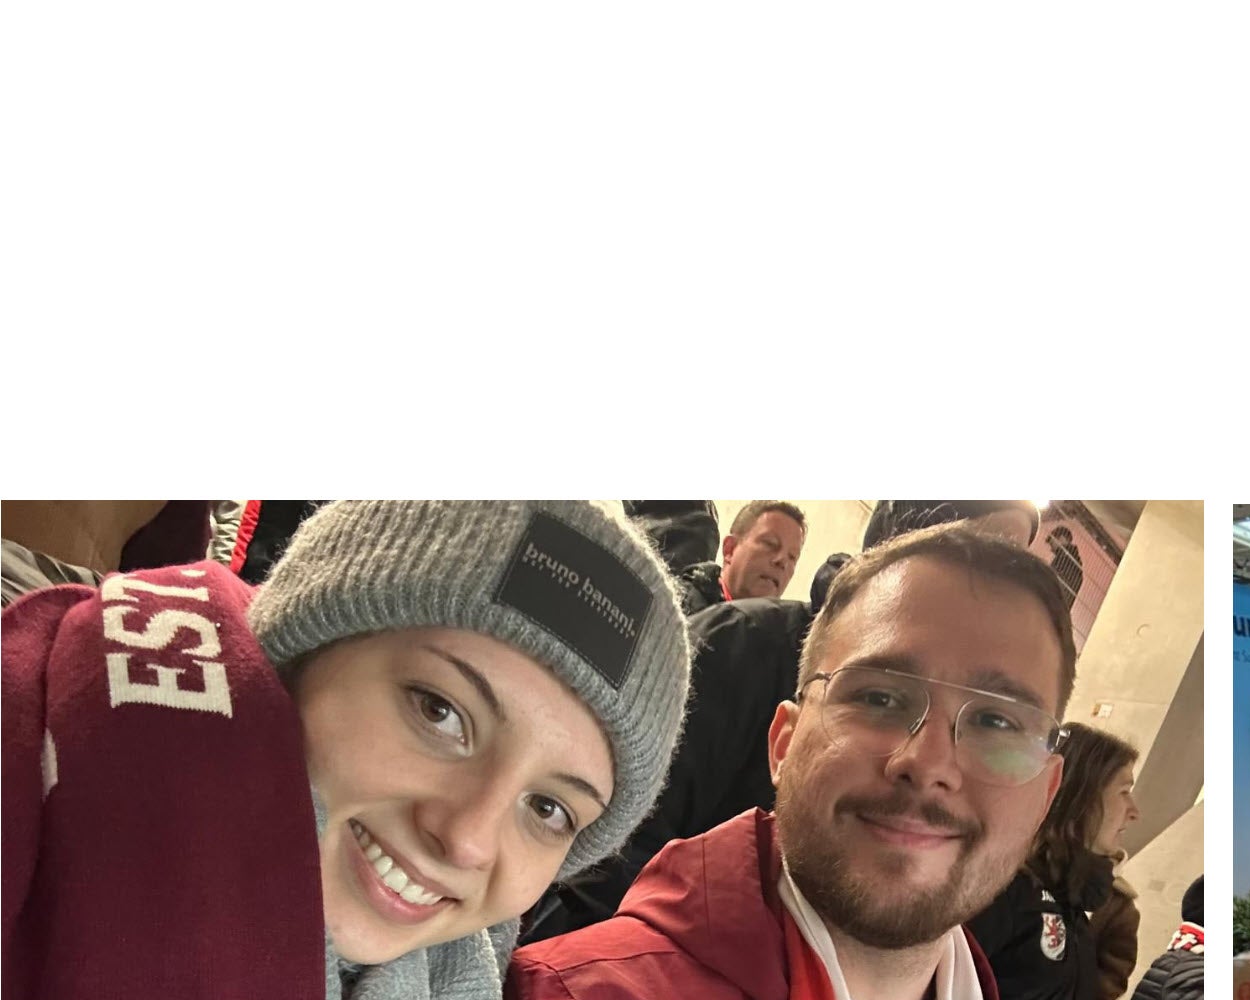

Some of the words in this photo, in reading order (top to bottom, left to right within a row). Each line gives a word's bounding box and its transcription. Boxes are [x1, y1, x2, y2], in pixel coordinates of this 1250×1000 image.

[101, 569, 233, 718] EST.
[524, 543, 580, 586] bruno
[582, 576, 637, 637] banani.
